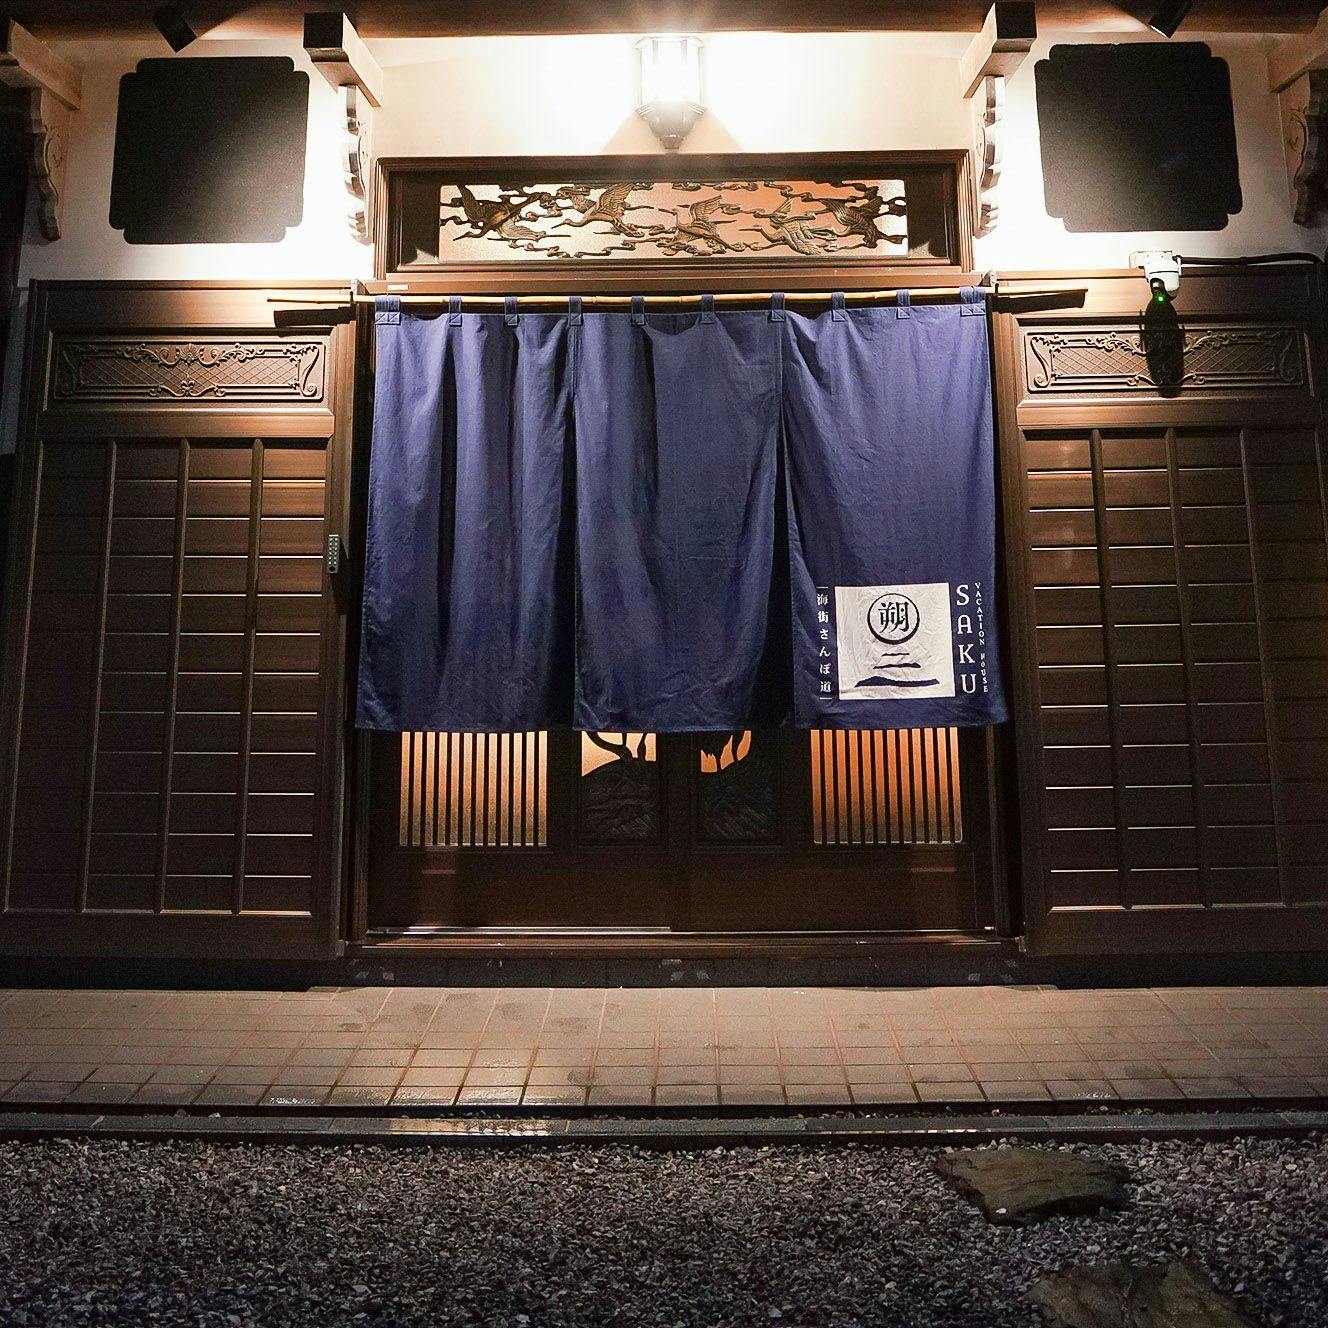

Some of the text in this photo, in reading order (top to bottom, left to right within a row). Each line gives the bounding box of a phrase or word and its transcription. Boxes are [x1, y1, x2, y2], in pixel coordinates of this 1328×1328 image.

[878, 601, 910, 633] 朔
[955, 584, 977, 694] SAKU
[974, 582, 989, 693] VACATION HOUSE
